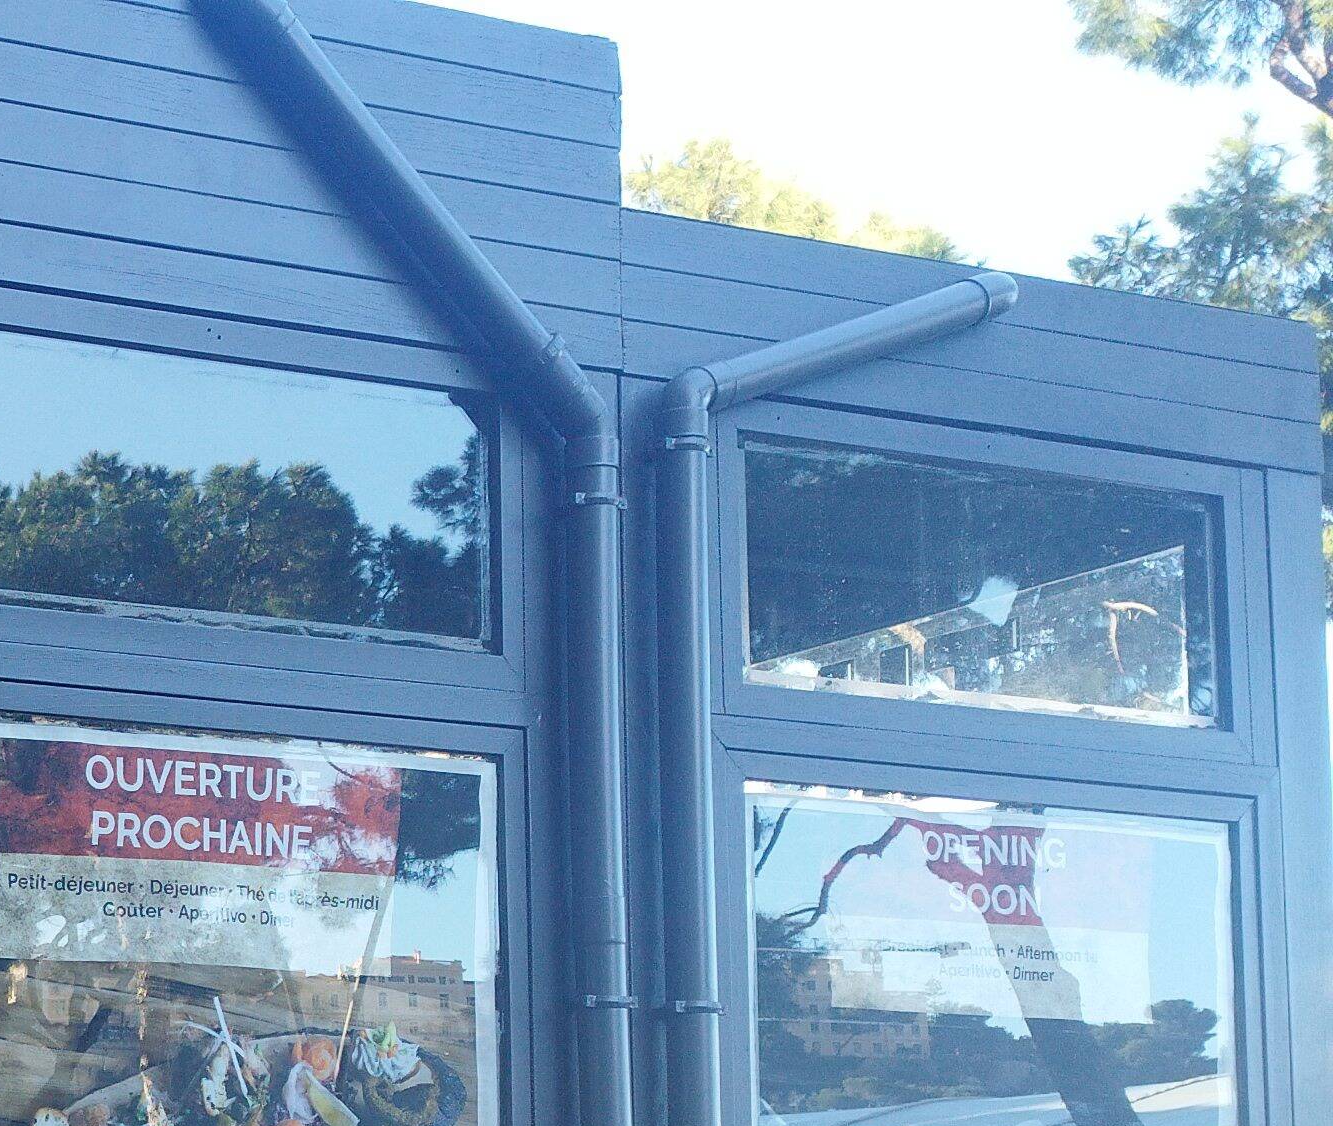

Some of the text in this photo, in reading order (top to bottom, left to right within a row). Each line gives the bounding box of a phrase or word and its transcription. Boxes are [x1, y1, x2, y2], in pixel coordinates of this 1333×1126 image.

[85, 754, 321, 807] OUVERTURE
[90, 810, 313, 860] PROCHAINE
[923, 831, 1067, 868] OPENING
[7, 873, 134, 895] Petit-déjeuner
[150, 879, 224, 898] Déjeuner
[949, 882, 1043, 916] SOON
[102, 901, 164, 919] Goûter
[1013, 966, 1055, 982] Dinner
